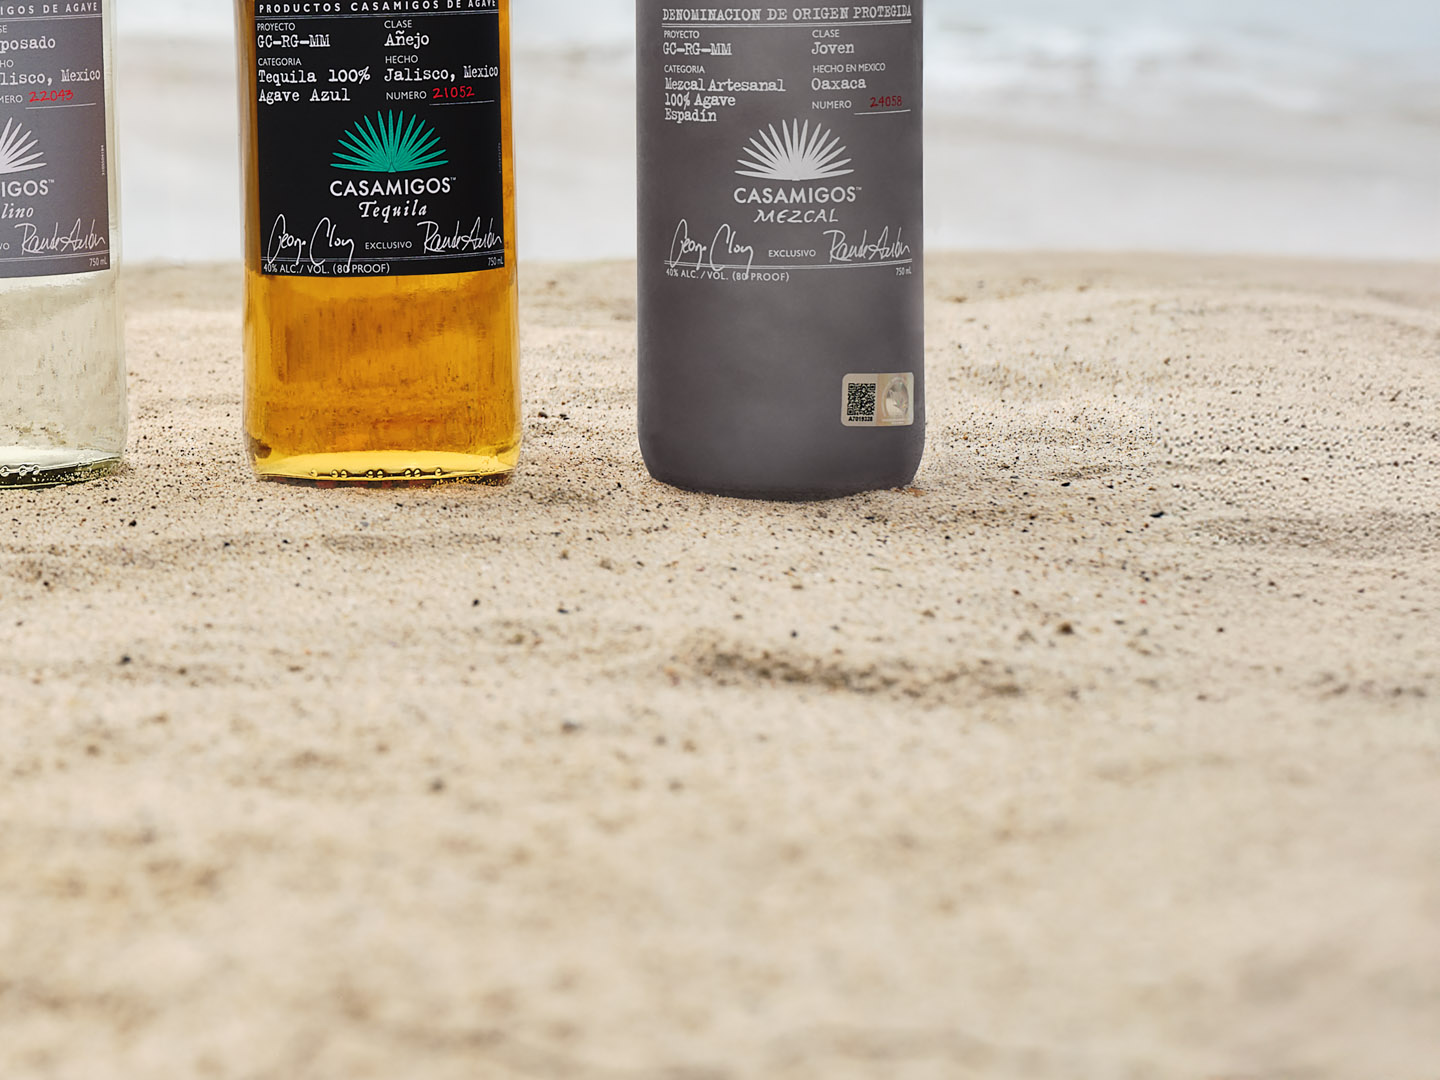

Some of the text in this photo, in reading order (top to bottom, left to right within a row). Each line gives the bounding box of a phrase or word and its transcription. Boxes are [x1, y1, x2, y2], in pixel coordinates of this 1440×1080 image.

[43, 4, 58, 14] DE
[65, 1, 98, 13] AGAVE
[259, 2, 342, 14] PRODUCTOS
[350, 0, 439, 12] CASAMIGOS
[447, 0, 462, 9] DE
[661, 4, 912, 21] DENOMINACION DE ORIGEN PROTEGIDA
[256, 22, 296, 32] PROYECTO
[384, 19, 413, 29] CLASE
[384, 30, 430, 49] Añejo
[663, 30, 700, 39] PROYECTO
[811, 29, 840, 38] CLASE
[257, 34, 331, 49] GC-RG-MM
[811, 41, 855, 55] Joven
[662, 42, 732, 56] GC-RG-MM
[257, 57, 302, 67] CATEGORIA
[385, 54, 418, 64] HECHO
[384, 65, 499, 82] Jalisco, Mexico
[663, 65, 705, 74] CATEGORIA
[812, 62, 886, 73] HECHO EN MEXICO
[60, 69, 101, 82] Mexico
[258, 66, 371, 86] Tequila 100%
[664, 77, 787, 92] Mezcal Artesanal
[811, 77, 867, 91] Oaxaca
[28, 89, 74, 103] 22043
[258, 88, 351, 105] Agave Azul
[385, 86, 476, 100] NUMERO 21052
[664, 93, 736, 108] 100% Agave
[811, 95, 903, 110] NUMERO 24058
[664, 107, 717, 124] Espadín
[358, 199, 428, 224] Tequila
[753, 208, 838, 224] MEZCAL
[365, 240, 413, 250] EXCLUSIVO
[768, 249, 816, 258] EXCLUSIVO
[89, 257, 99, 267] 750
[487, 256, 498, 266] 750
[263, 263, 278, 273] 40%
[306, 264, 330, 275] VOL.
[350, 262, 390, 274] PROOF)
[666, 267, 679, 278] 40%
[750, 272, 790, 283] PROOF)
[895, 266, 905, 276] 750
